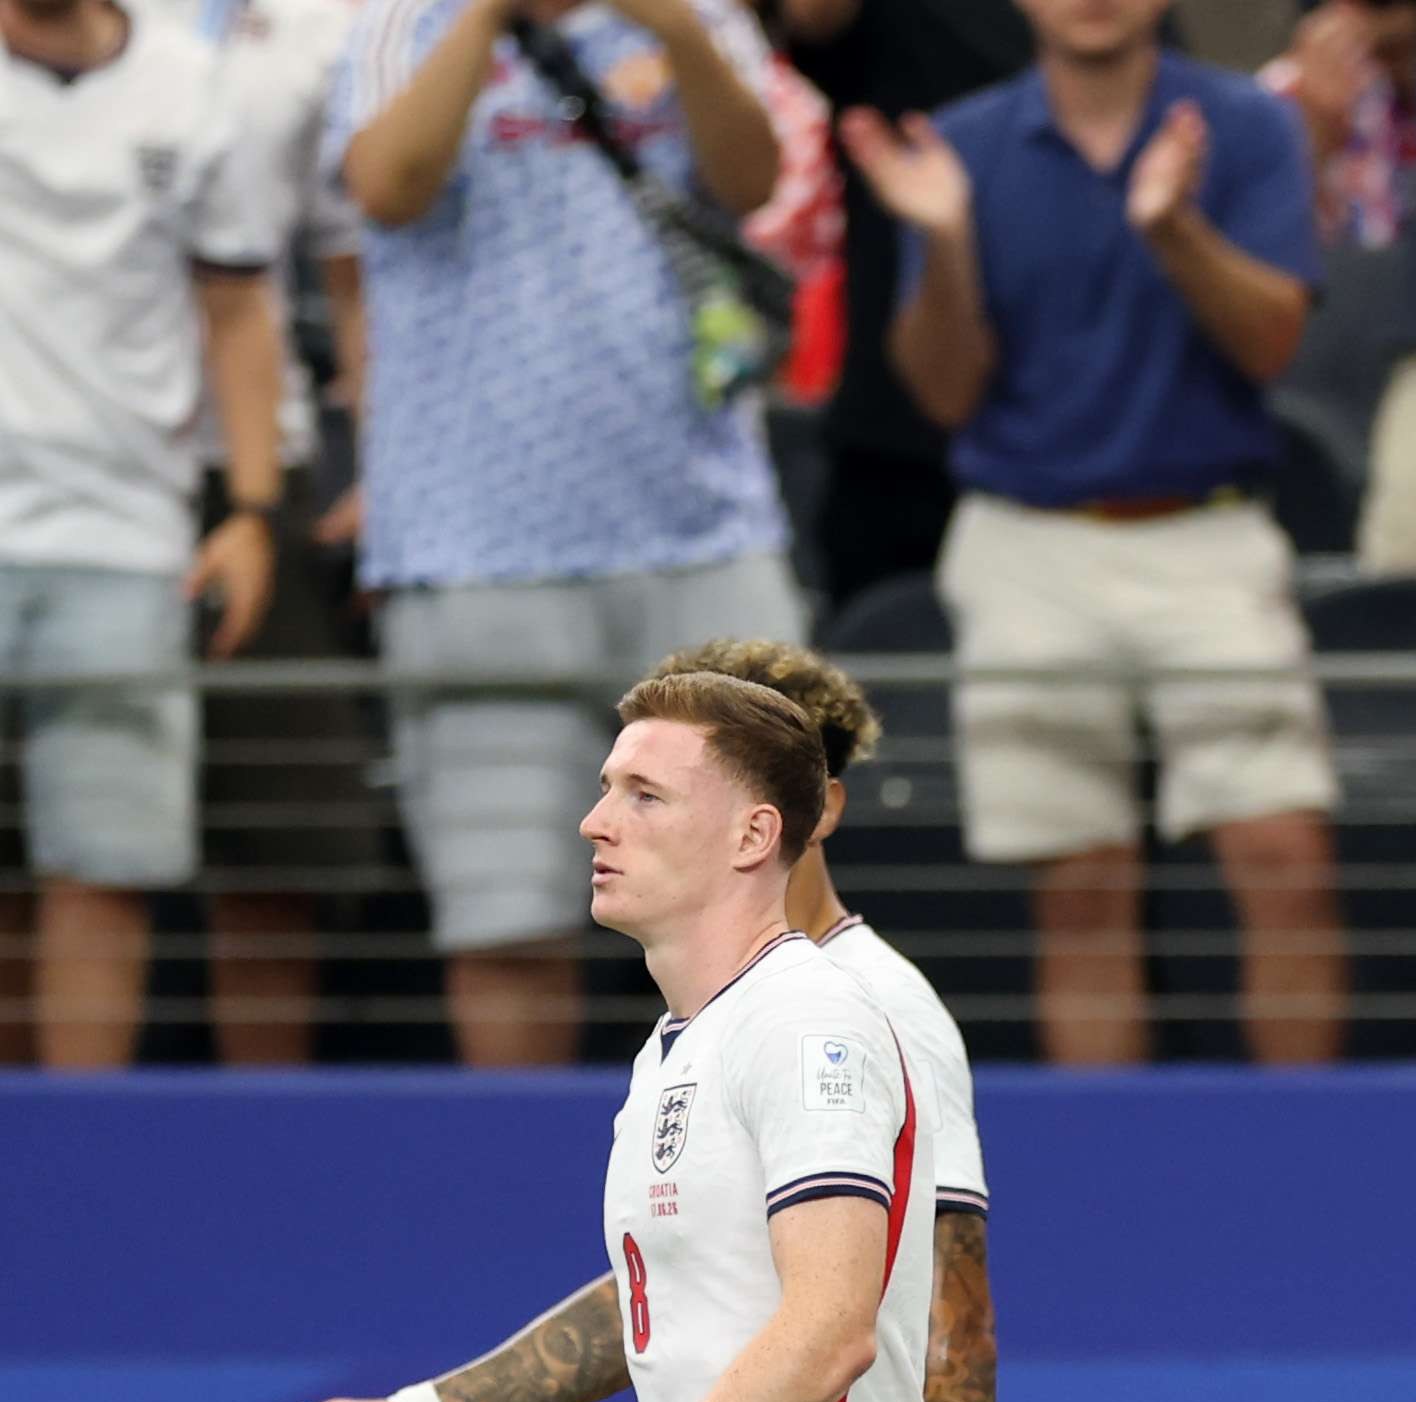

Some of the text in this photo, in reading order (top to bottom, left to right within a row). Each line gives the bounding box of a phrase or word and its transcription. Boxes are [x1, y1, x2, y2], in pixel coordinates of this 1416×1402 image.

[820, 1082, 853, 1097] PEACE
[648, 1182, 679, 1199] CROATIA
[622, 1232, 650, 1354] 8
